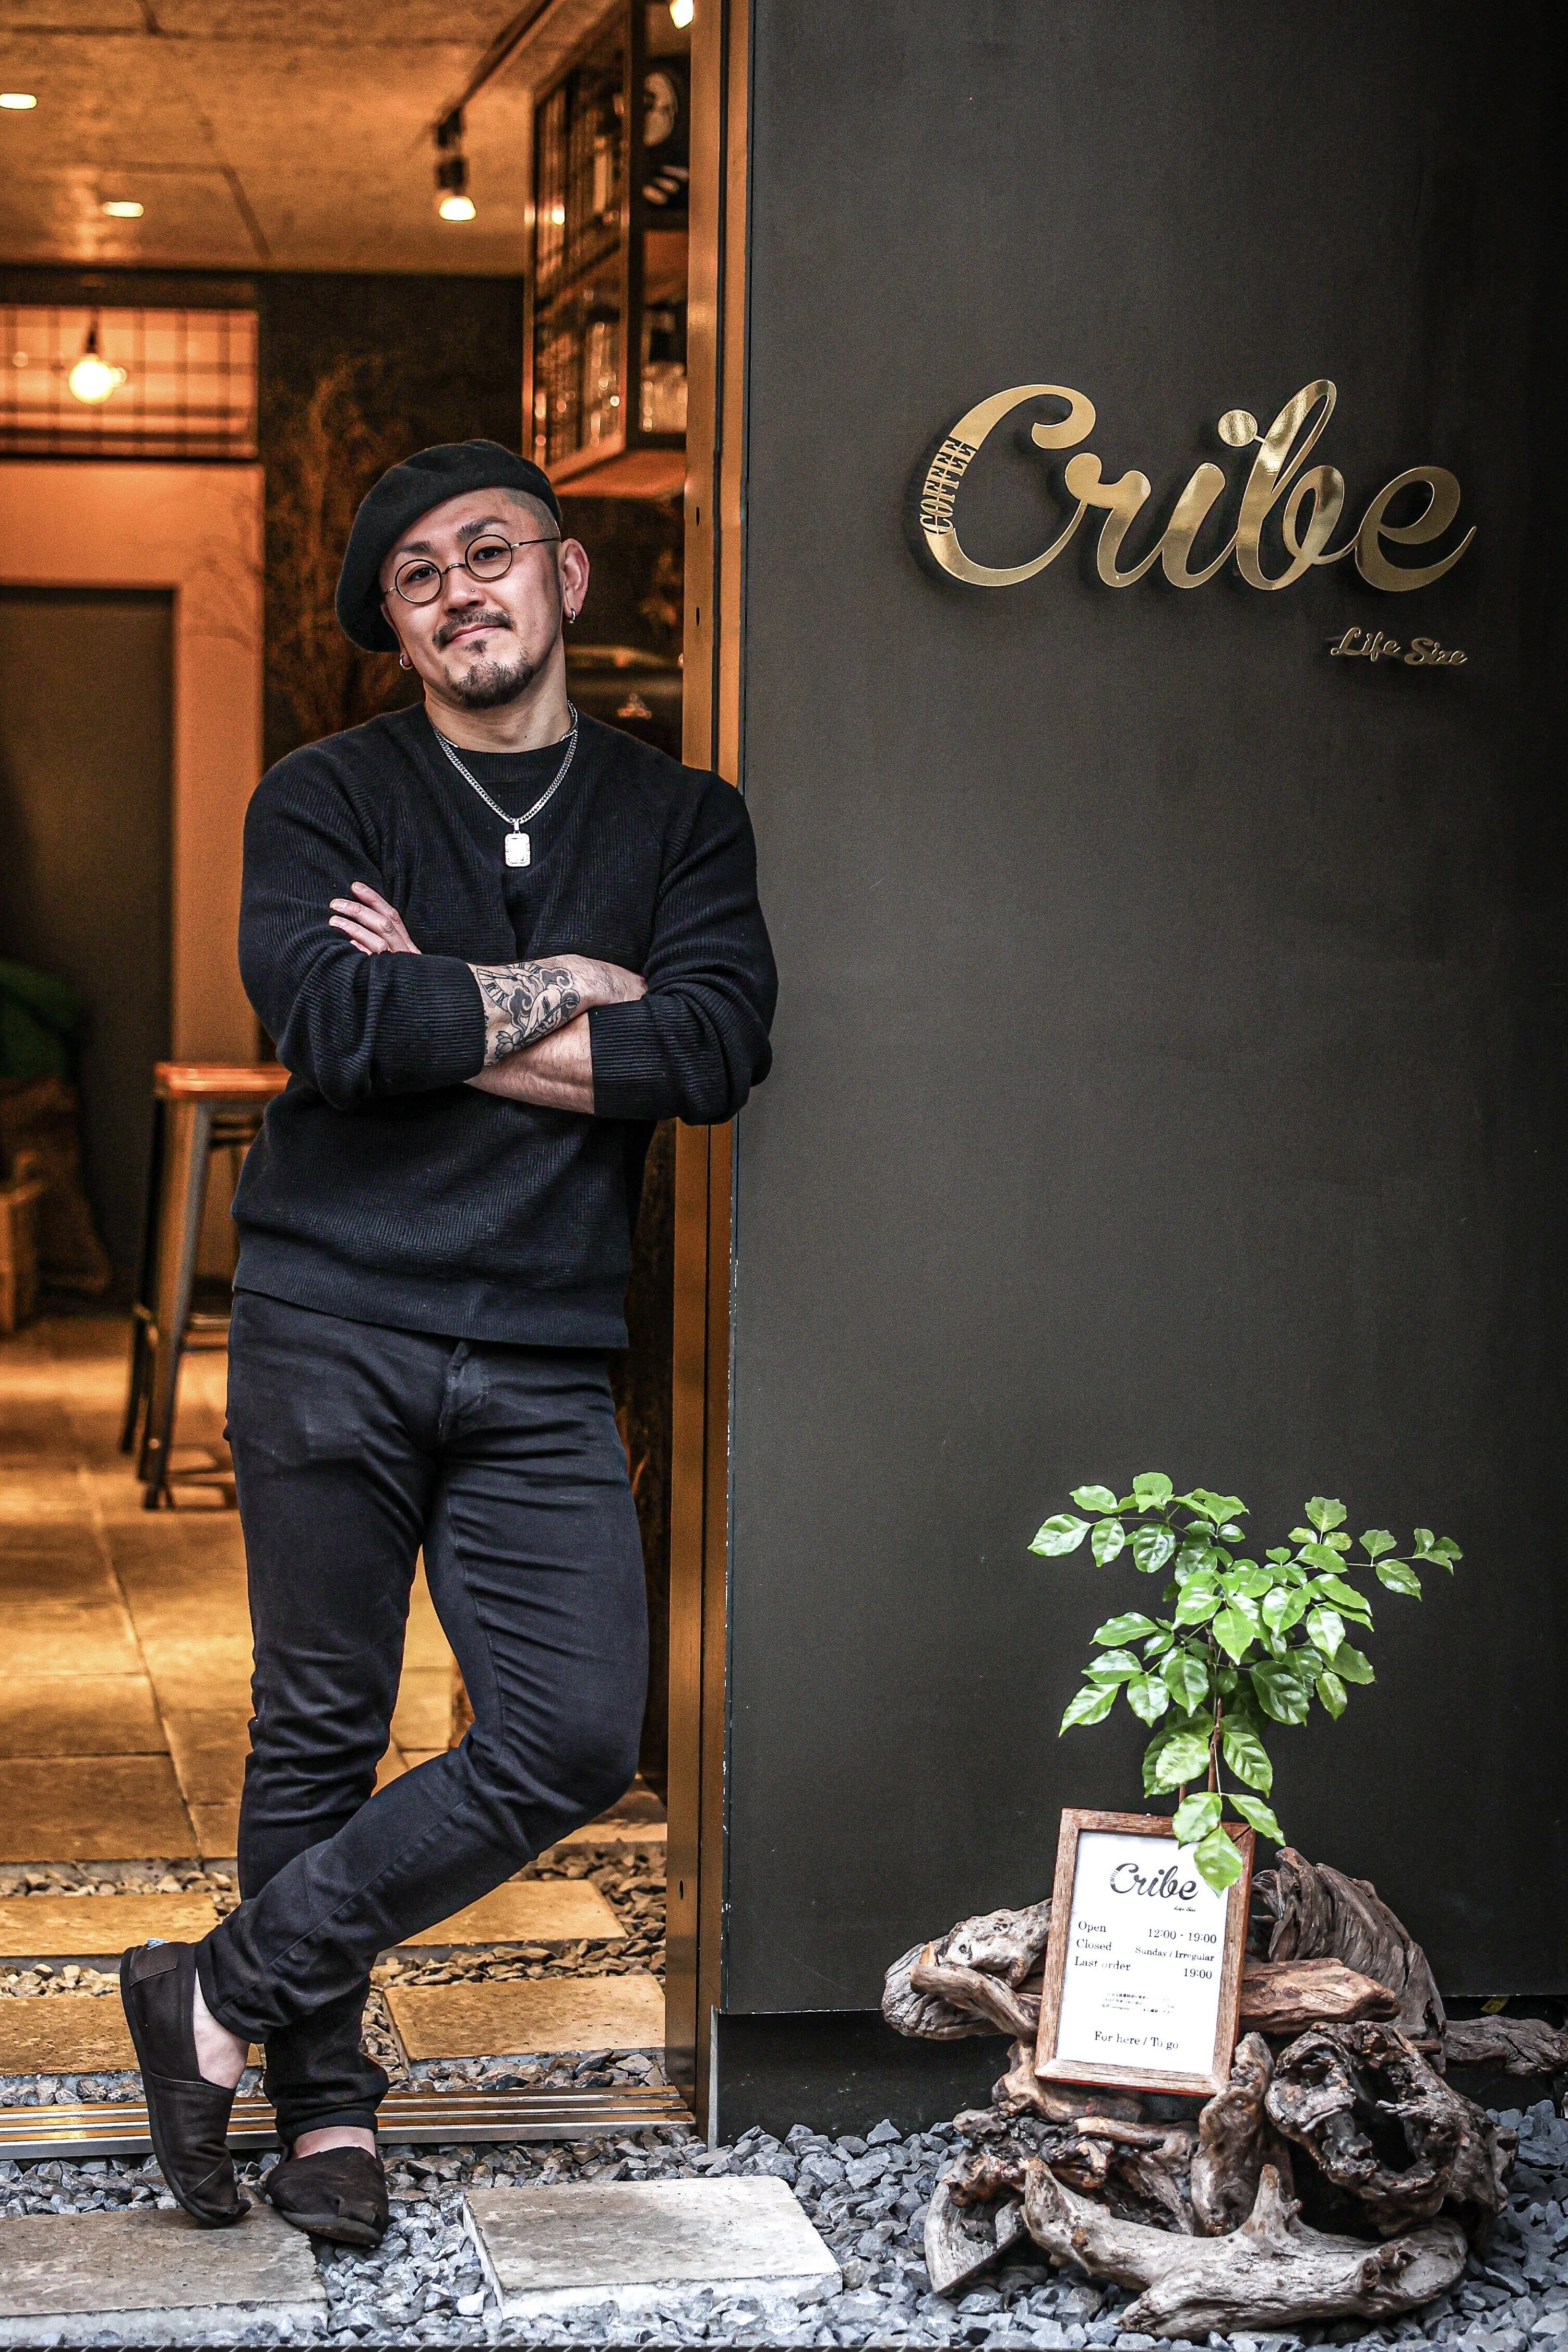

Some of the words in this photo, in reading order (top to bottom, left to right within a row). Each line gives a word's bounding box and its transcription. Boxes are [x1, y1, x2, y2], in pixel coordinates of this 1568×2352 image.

[919, 379, 1477, 592] Cribe
[919, 439, 977, 536] COFFEE
[1331, 627, 1401, 662] Life
[1404, 637, 1467, 665] Size
[1110, 1864, 1199, 1900] Cribe
[1079, 1921, 1106, 1932] Open
[1148, 1929, 1176, 1940] 12:00
[1189, 1933, 1216, 1943] 19:00
[1076, 1939, 1111, 1950] Closed
[1135, 1947, 1167, 1957] Sunday
[1175, 1951, 1214, 1961] Irregular
[1075, 1956, 1098, 1967] Last
[1102, 1961, 1130, 1971] order
[1184, 1968, 1212, 1979] 19:00
[1095, 2031, 1112, 2041] For
[1117, 2034, 1140, 2045] here
[1151, 2037, 1163, 2046] To
